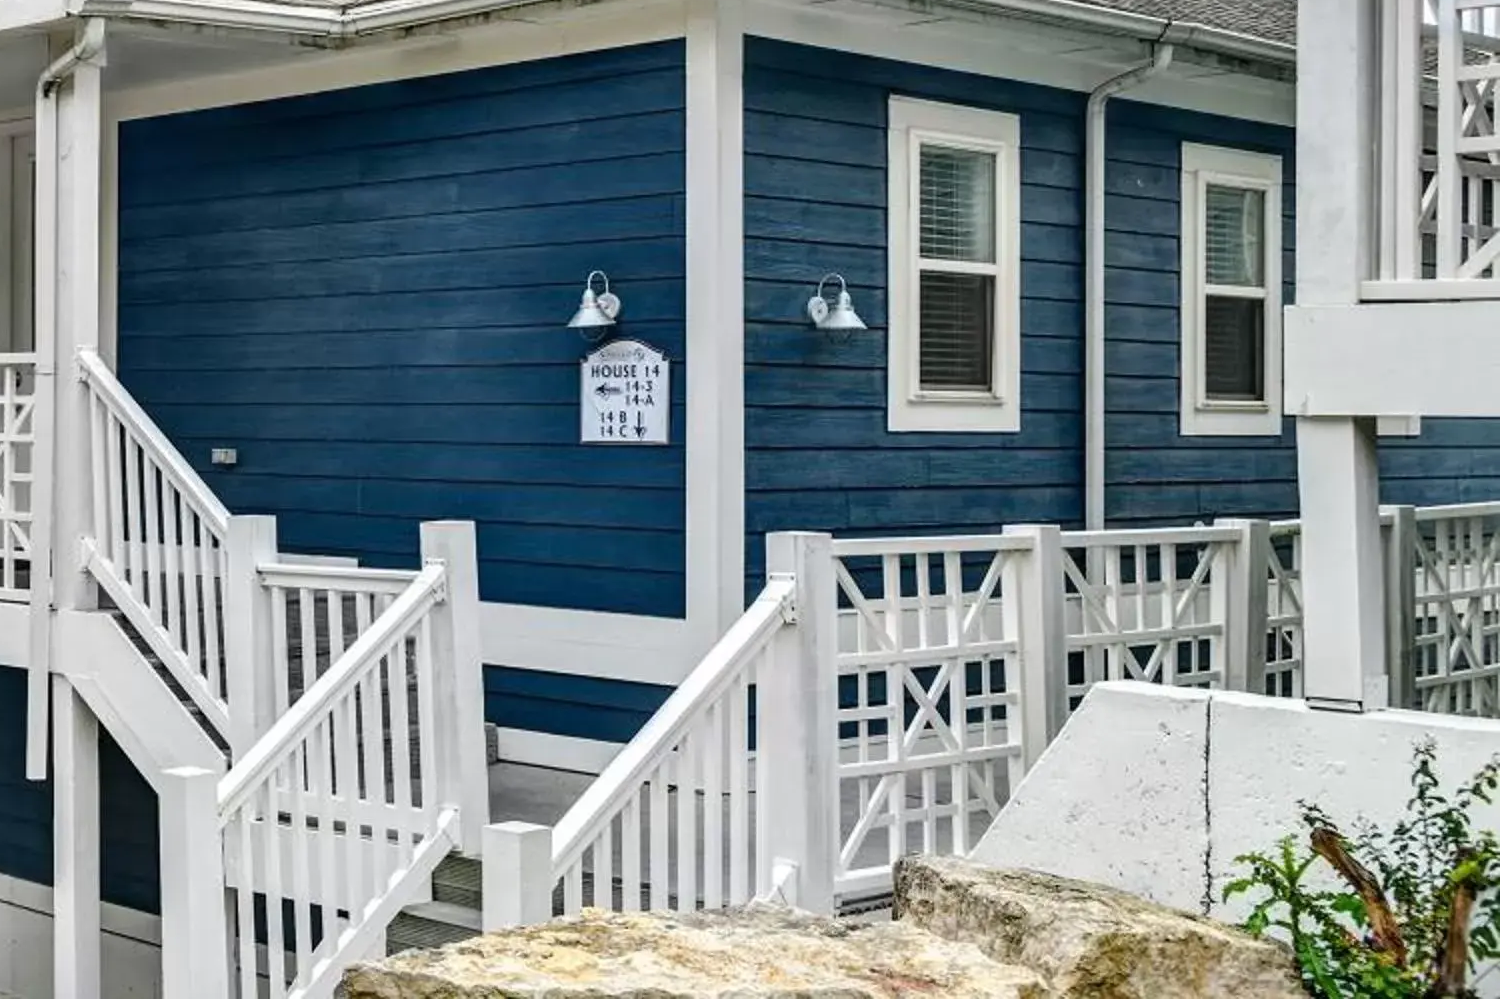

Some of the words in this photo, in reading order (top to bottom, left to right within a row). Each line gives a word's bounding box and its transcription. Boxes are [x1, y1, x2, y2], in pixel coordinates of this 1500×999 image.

[591, 364, 637, 378] HOUSE
[645, 364, 660, 378] 14
[625, 394, 655, 406] 14-A
[600, 411, 613, 423] 14
[619, 410, 627, 424] B
[600, 425, 613, 437] 14
[619, 424, 628, 438] C
